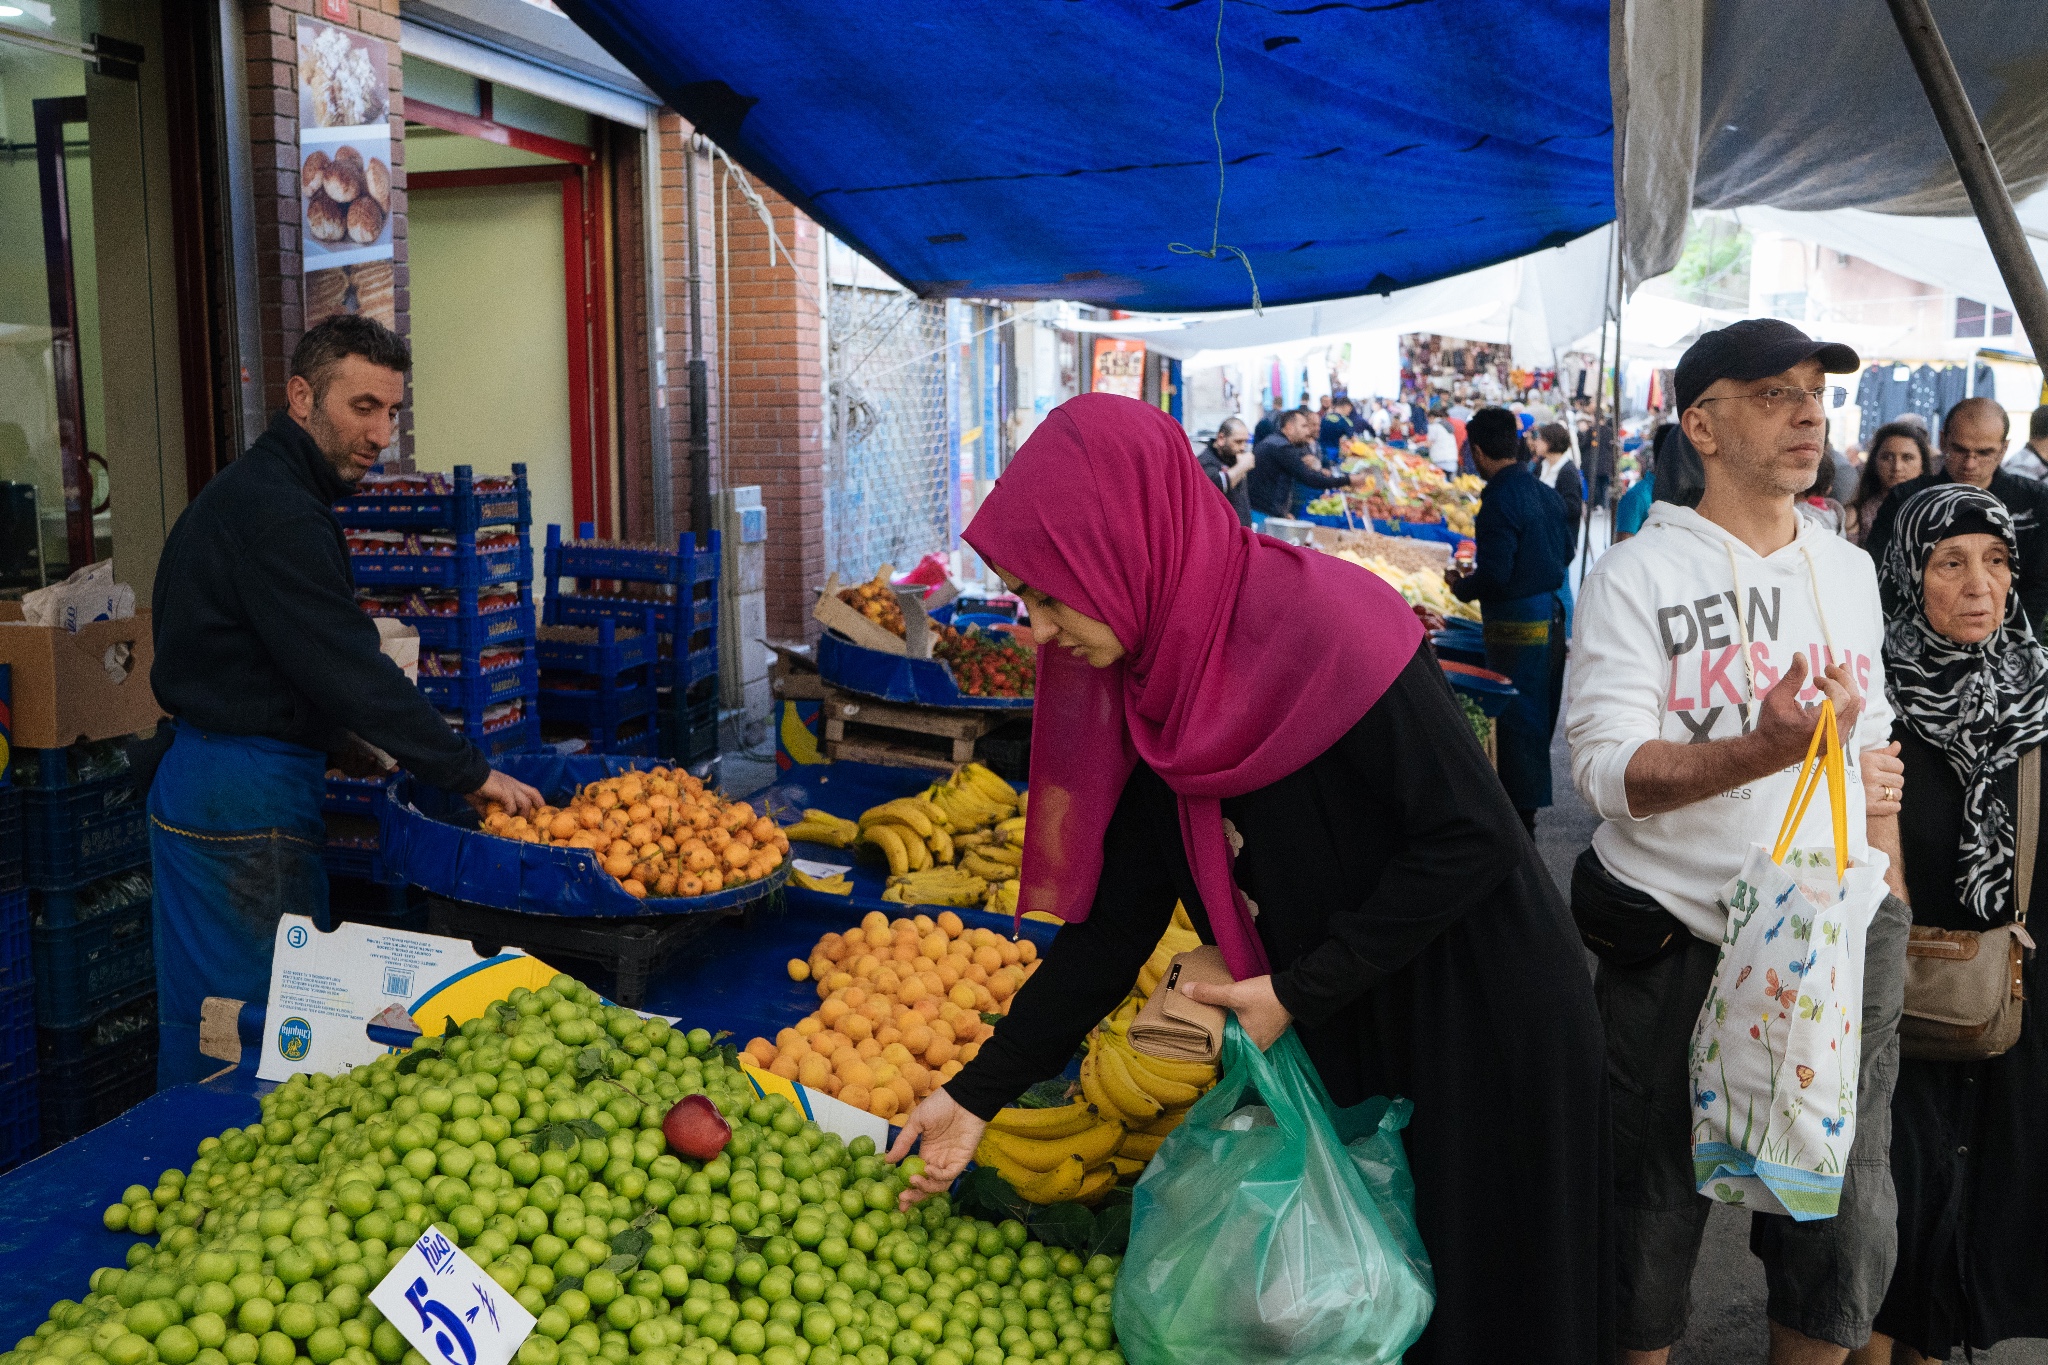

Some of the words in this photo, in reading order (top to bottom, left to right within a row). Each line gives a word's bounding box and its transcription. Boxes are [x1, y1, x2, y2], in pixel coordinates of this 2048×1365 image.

[1658, 586, 1781, 661] DEW
[292, 930, 303, 945] E
[281, 1024, 311, 1041] Chiquita
[404, 1276, 477, 1365] 5
